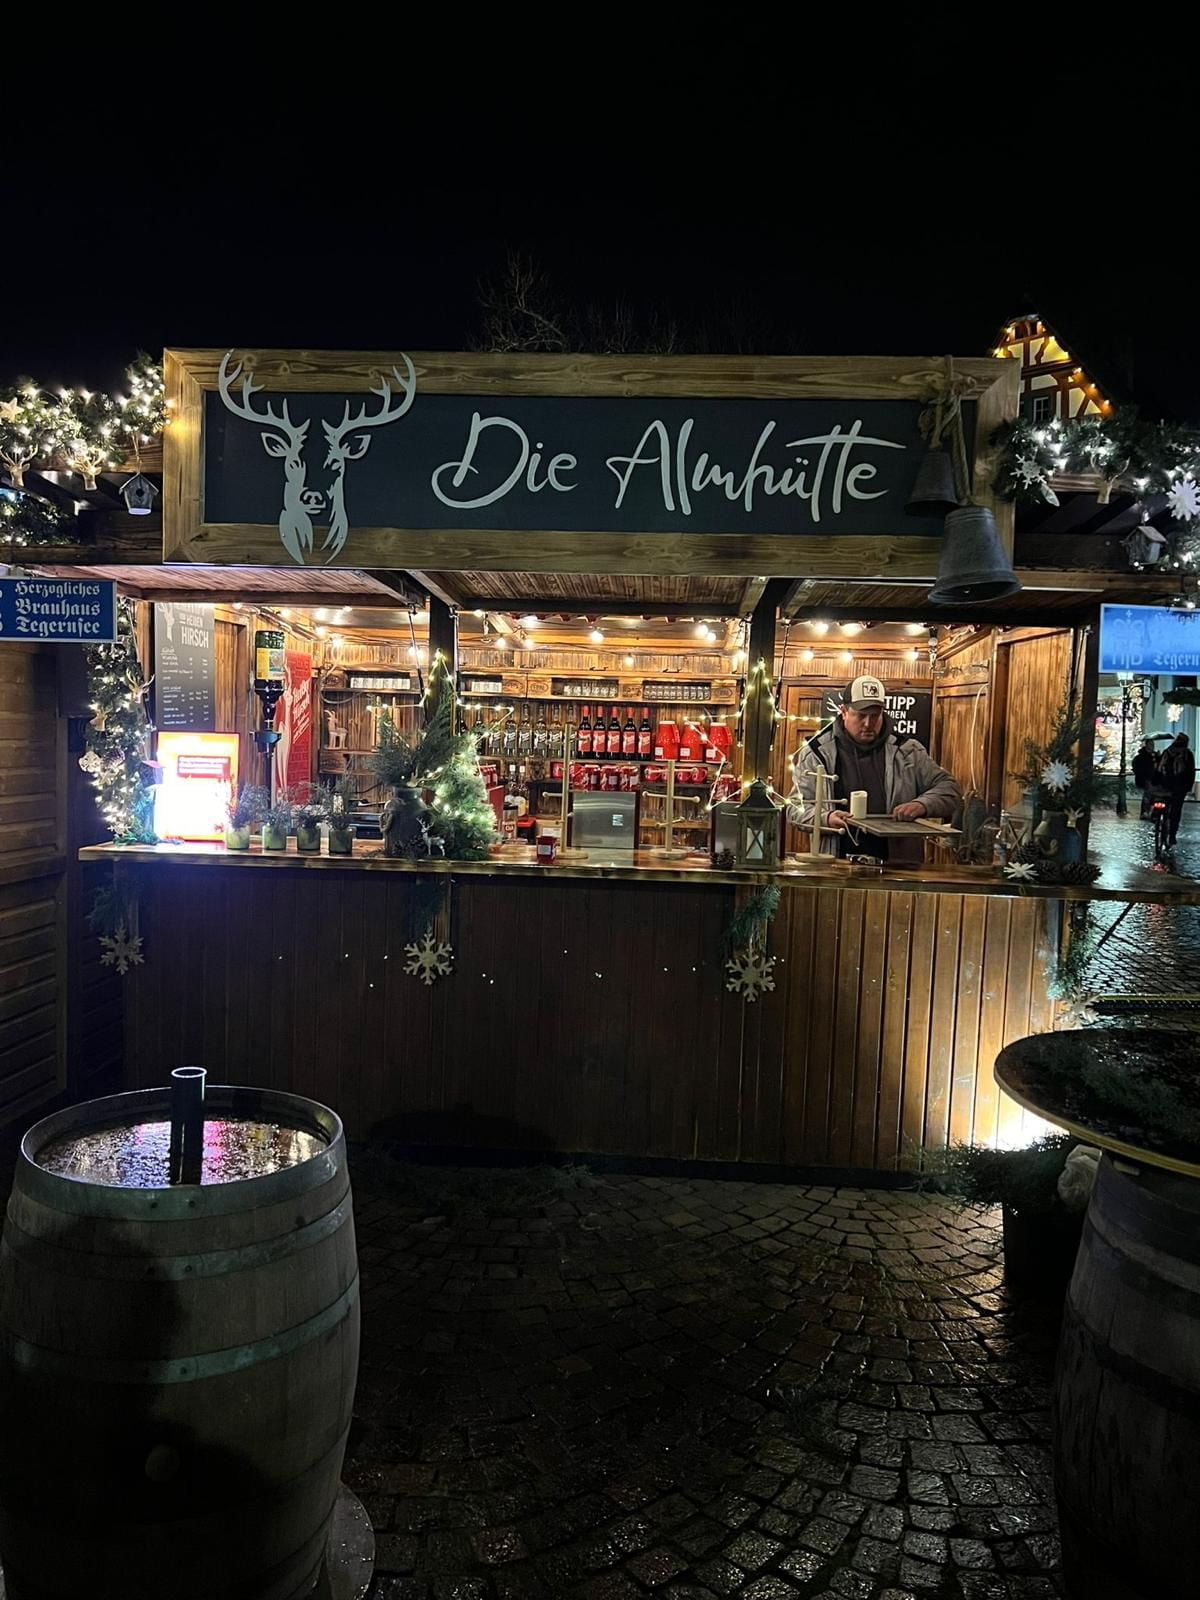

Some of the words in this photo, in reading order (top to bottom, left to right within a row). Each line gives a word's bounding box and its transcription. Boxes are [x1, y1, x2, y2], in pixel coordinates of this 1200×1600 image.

[432, 412, 576, 508] Die
[606, 419, 905, 521] Almhütte
[15, 581, 100, 598] Herzogliches
[15, 598, 101, 619] Brauhaus
[181, 626, 209, 649] HIRSCH
